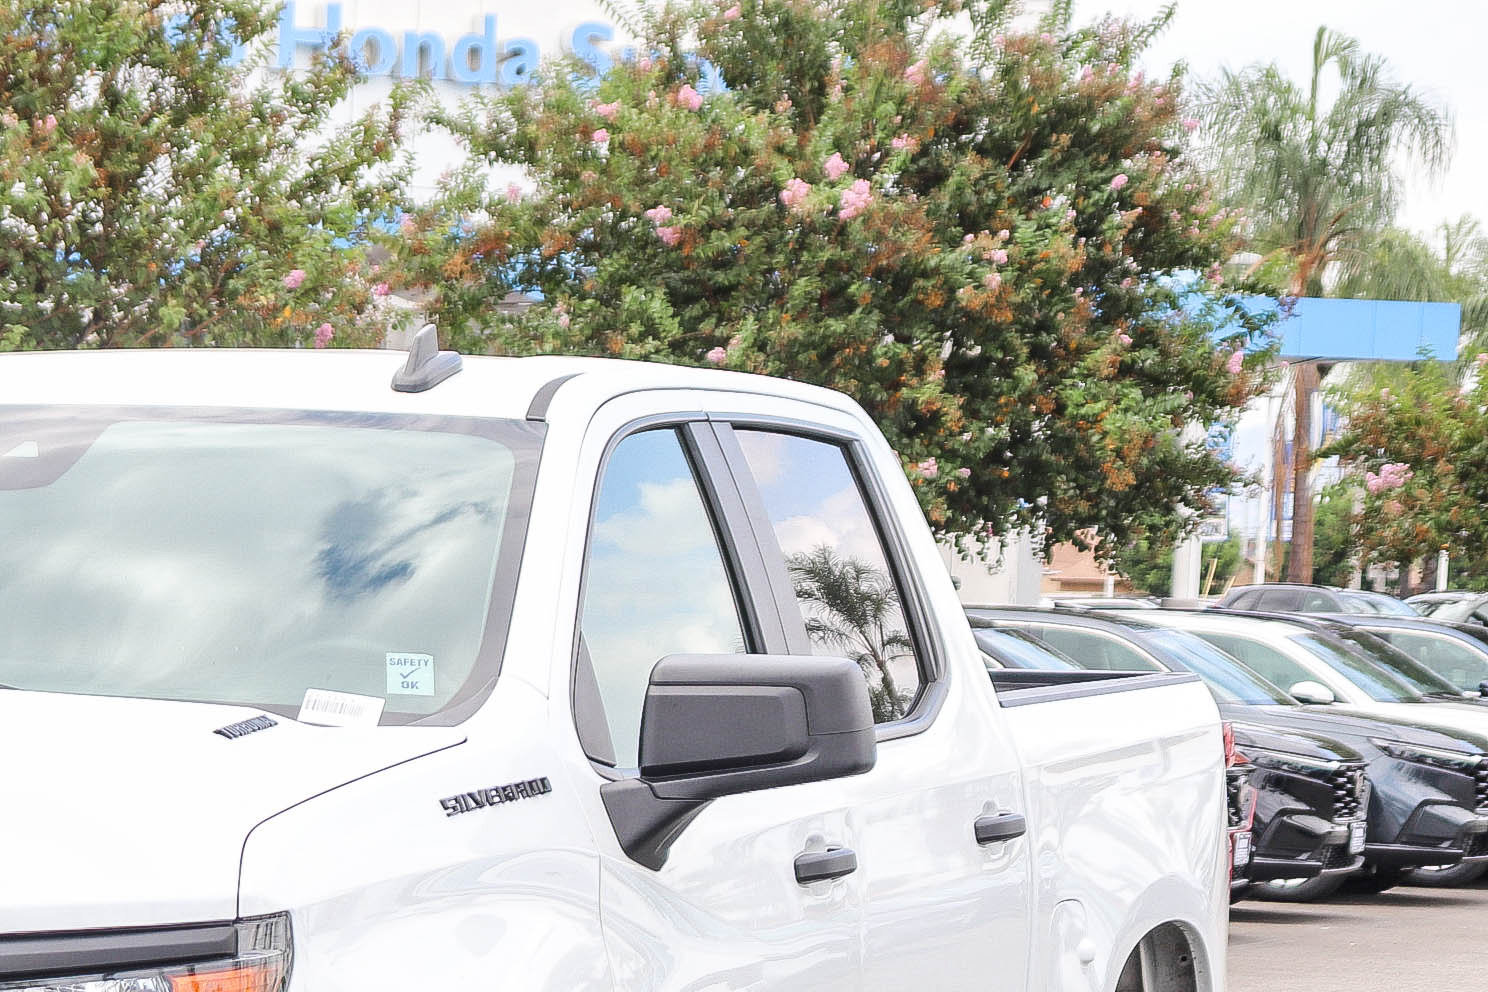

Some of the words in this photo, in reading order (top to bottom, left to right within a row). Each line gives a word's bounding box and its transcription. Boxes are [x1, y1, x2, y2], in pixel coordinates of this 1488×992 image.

[277, 0, 540, 88] Honda
[389, 657, 430, 667] SAFETY
[438, 775, 553, 818] SILVERADO
